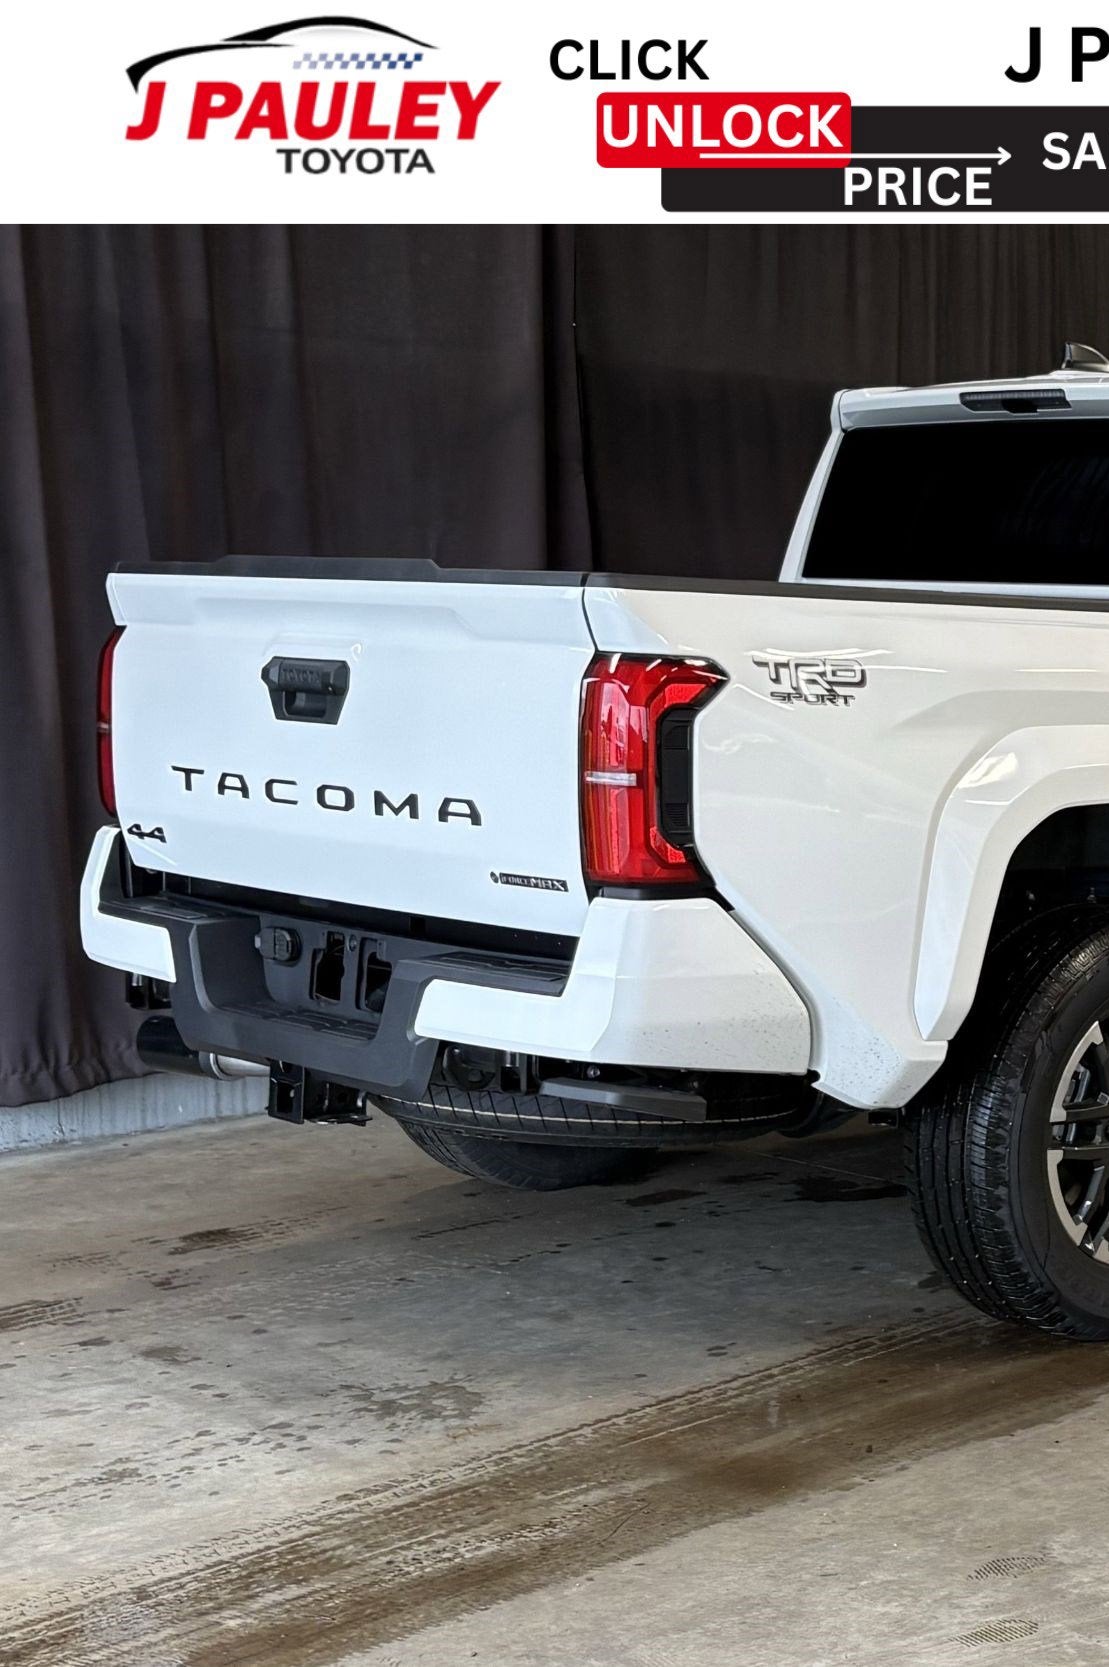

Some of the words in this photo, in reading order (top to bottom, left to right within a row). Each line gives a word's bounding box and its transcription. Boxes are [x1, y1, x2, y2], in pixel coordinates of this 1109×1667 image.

[751, 655, 867, 694] TRD
[770, 691, 856, 707] SPORT
[171, 765, 483, 826] TACOMA
